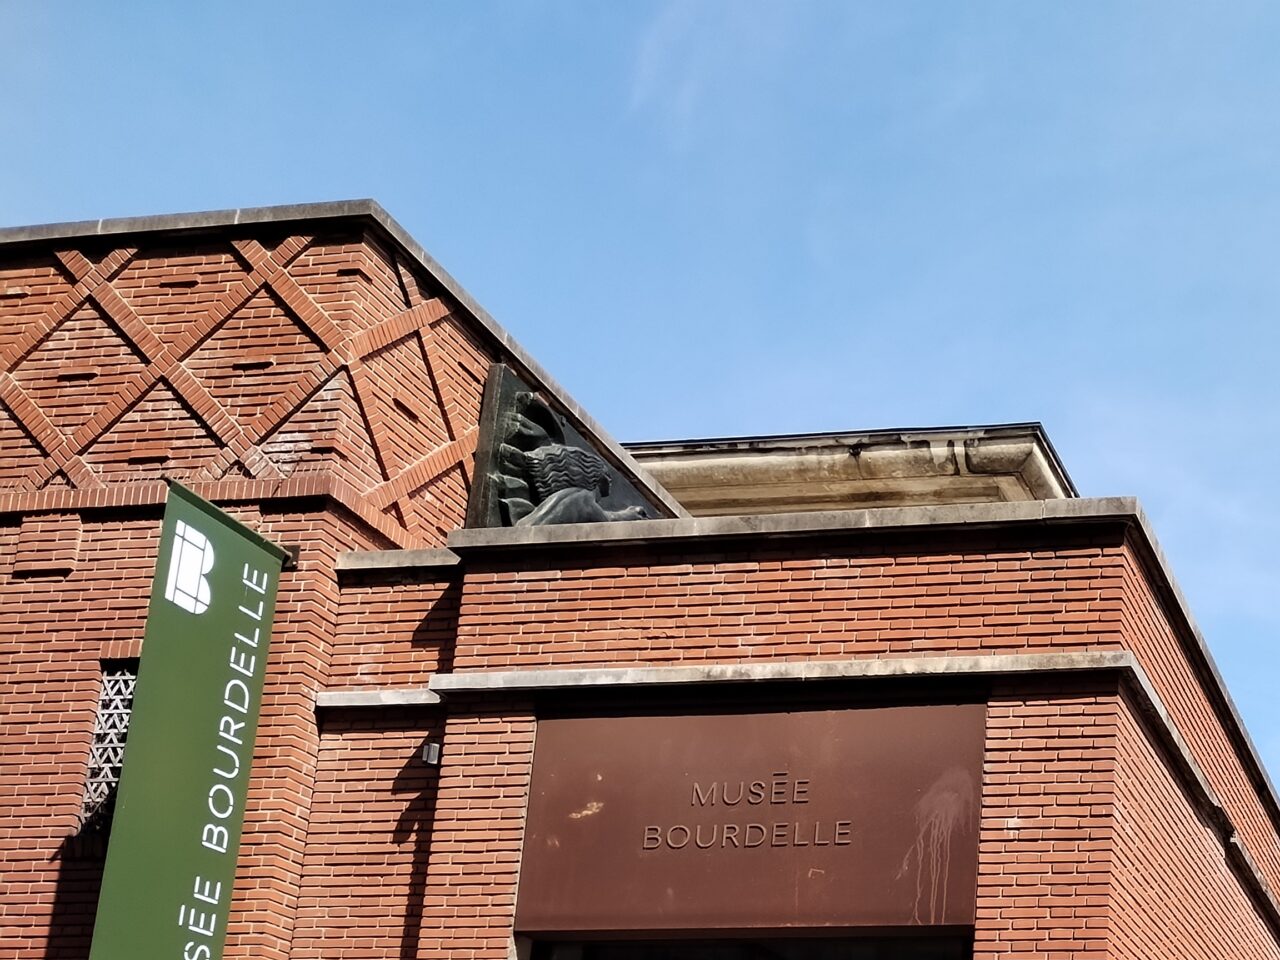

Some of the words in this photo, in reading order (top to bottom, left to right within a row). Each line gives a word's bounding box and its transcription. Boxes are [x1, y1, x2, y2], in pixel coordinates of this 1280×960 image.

[201, 562, 268, 853] BOURDELLE
[691, 771, 810, 806] MUSÉE
[643, 820, 852, 850] BOURDELLE
